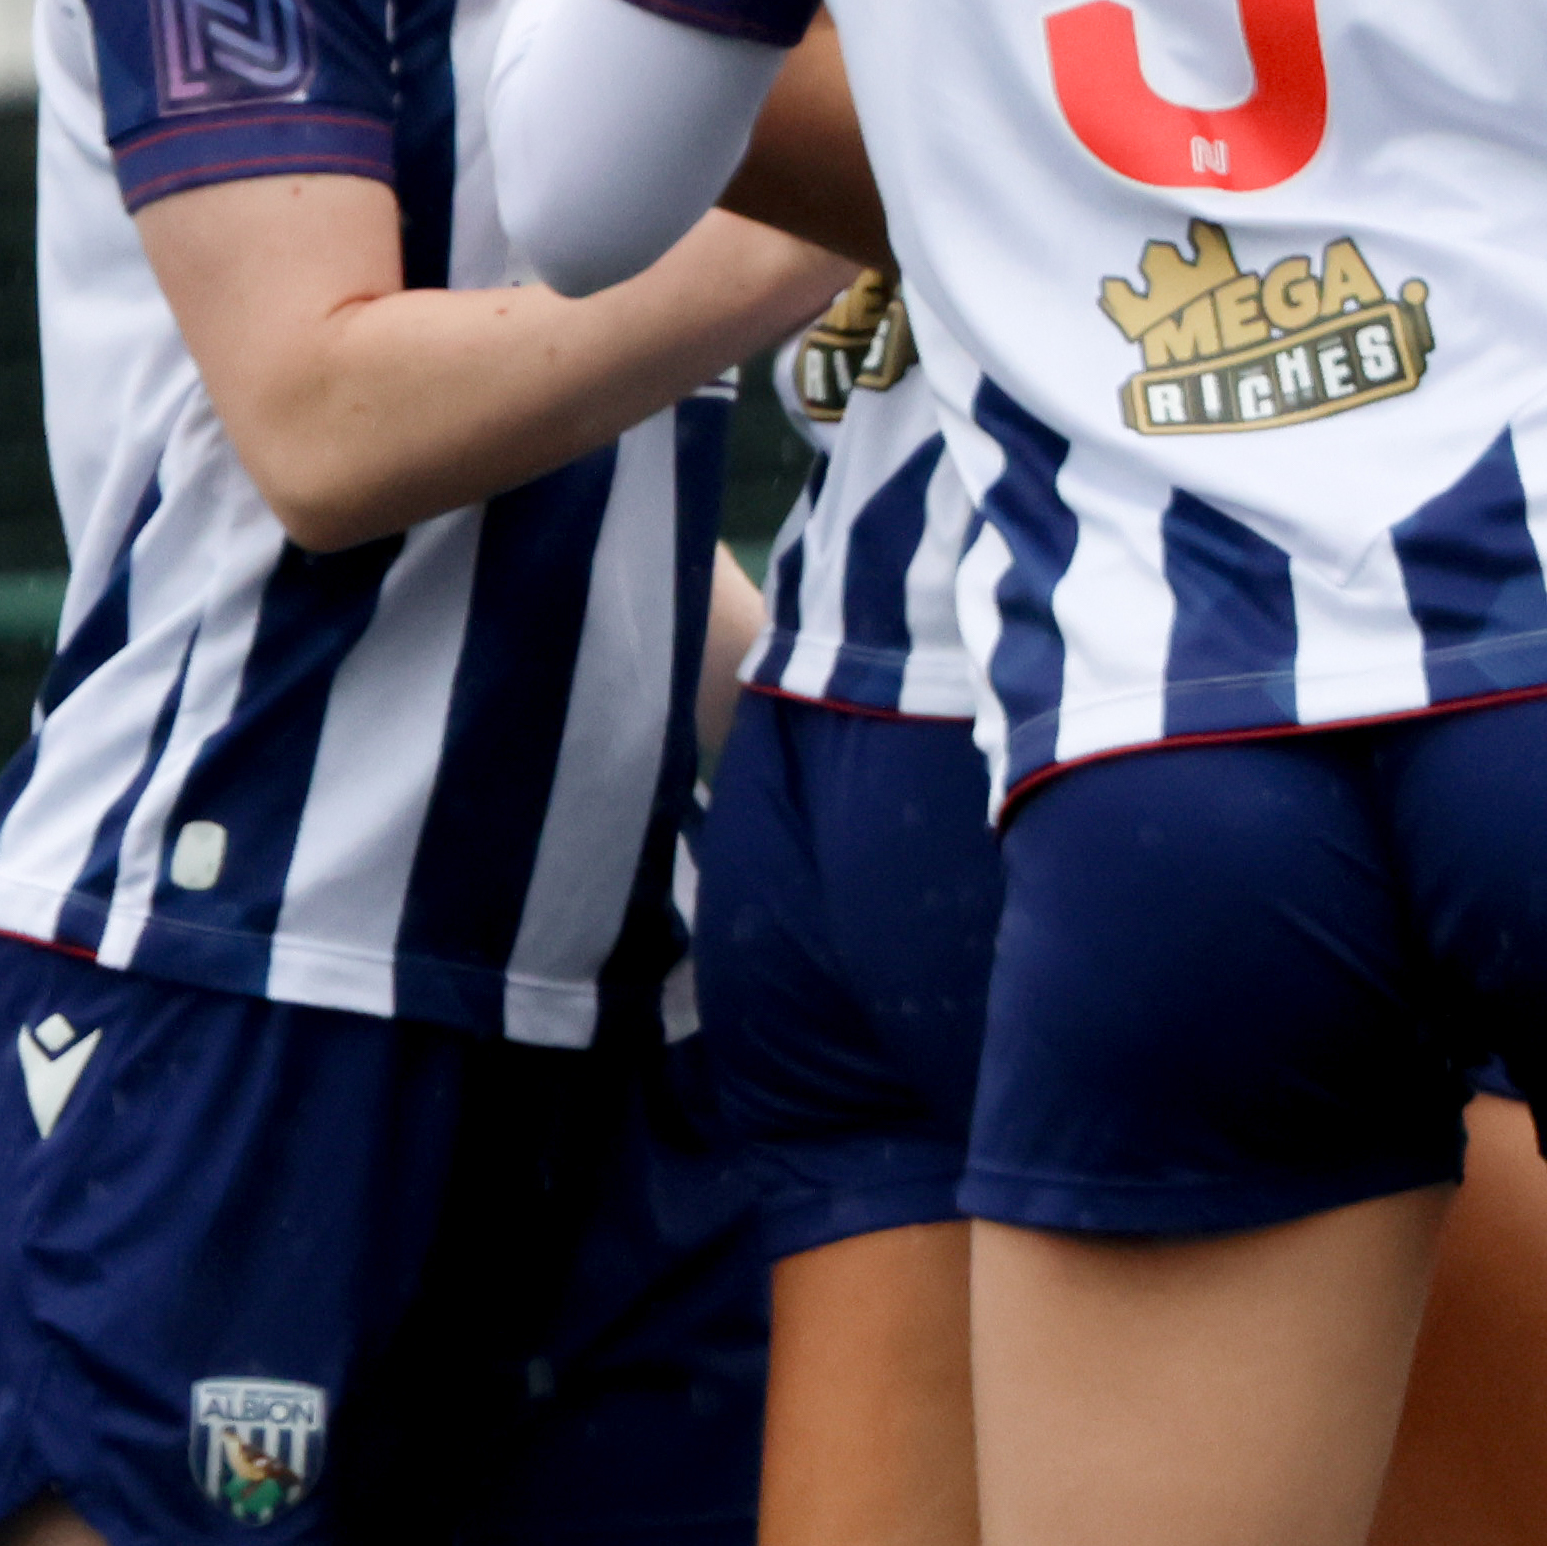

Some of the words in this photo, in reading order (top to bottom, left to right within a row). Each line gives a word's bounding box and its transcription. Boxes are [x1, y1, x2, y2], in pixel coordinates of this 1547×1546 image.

[1141, 236, 1387, 370] MEGA
[1146, 323, 1399, 425] RICHES
[201, 1395, 317, 1424] ALBION
